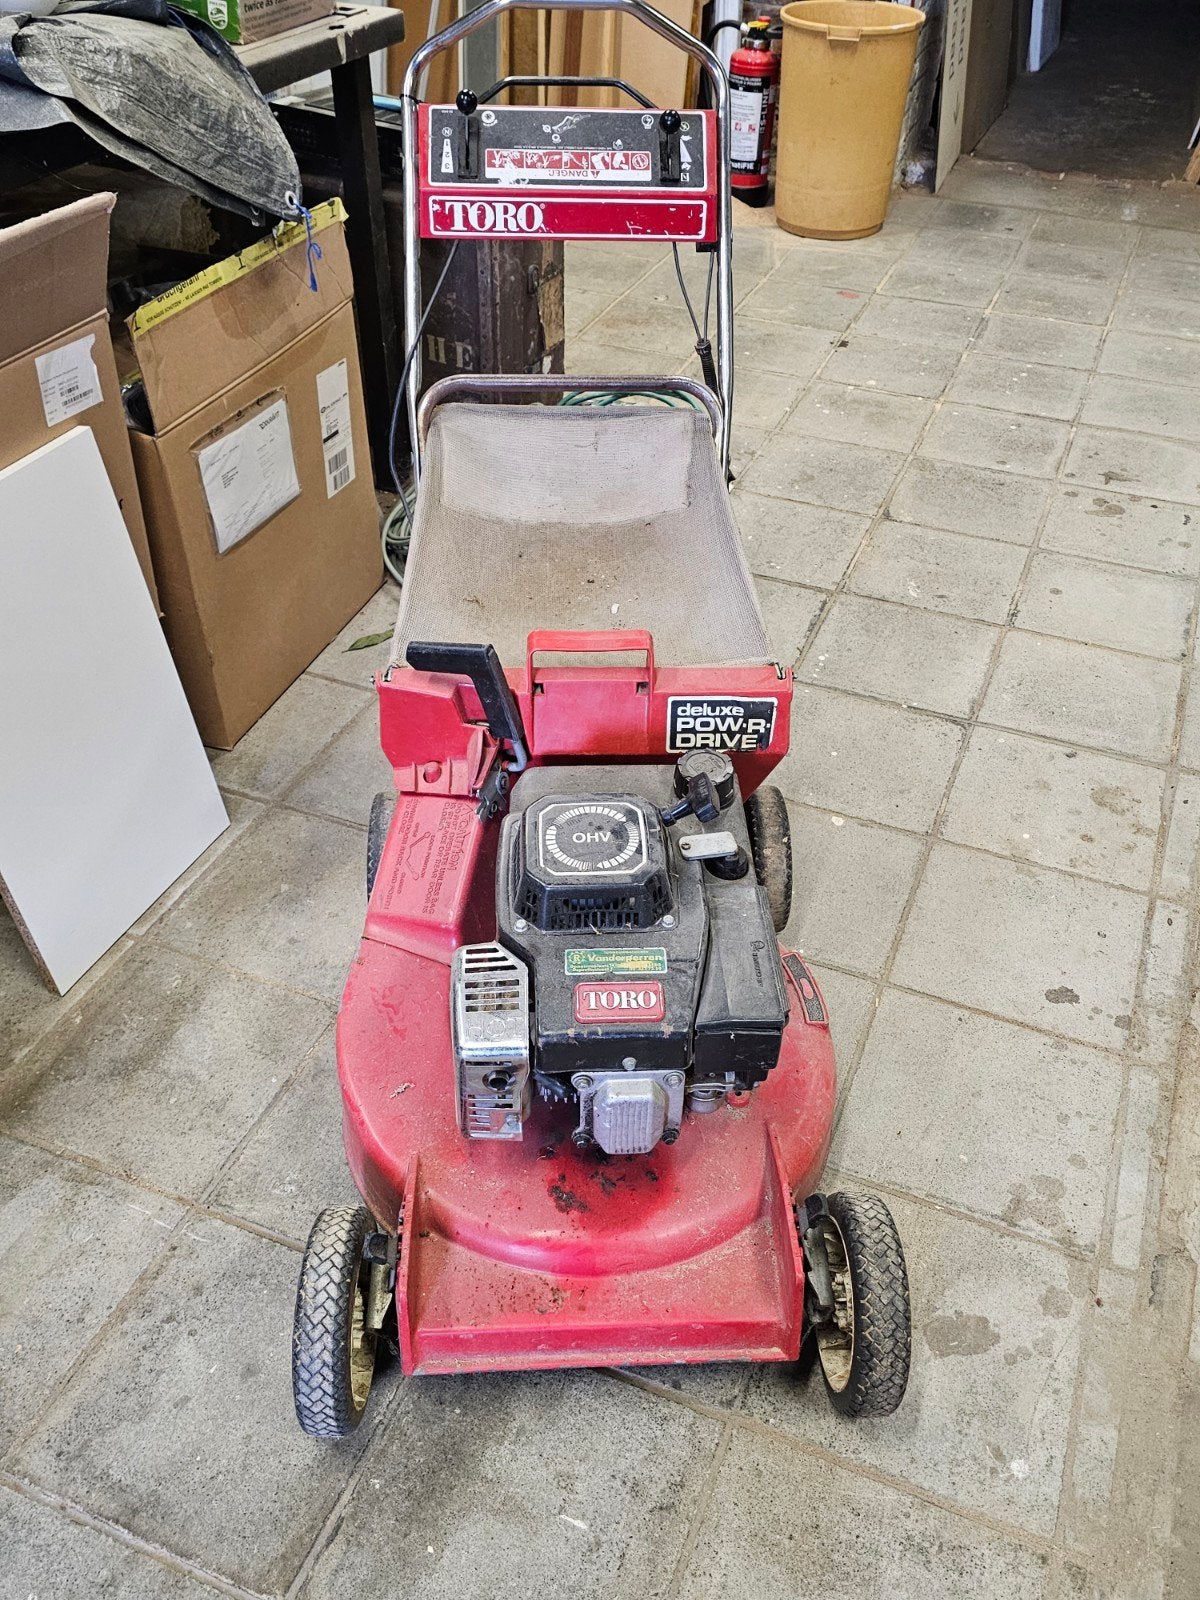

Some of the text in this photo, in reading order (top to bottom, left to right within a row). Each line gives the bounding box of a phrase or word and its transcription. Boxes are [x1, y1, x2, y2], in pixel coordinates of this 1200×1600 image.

[677, 703, 745, 716] deluxe
[675, 733, 758, 748] DRIVE
[572, 832, 611, 843] OHV
[440, 831, 455, 865] OPERATE
[432, 867, 445, 896] UNLESS
[423, 881, 435, 904] DOOR
[427, 898, 437, 914] BAG
[583, 990, 657, 1010] TORO
